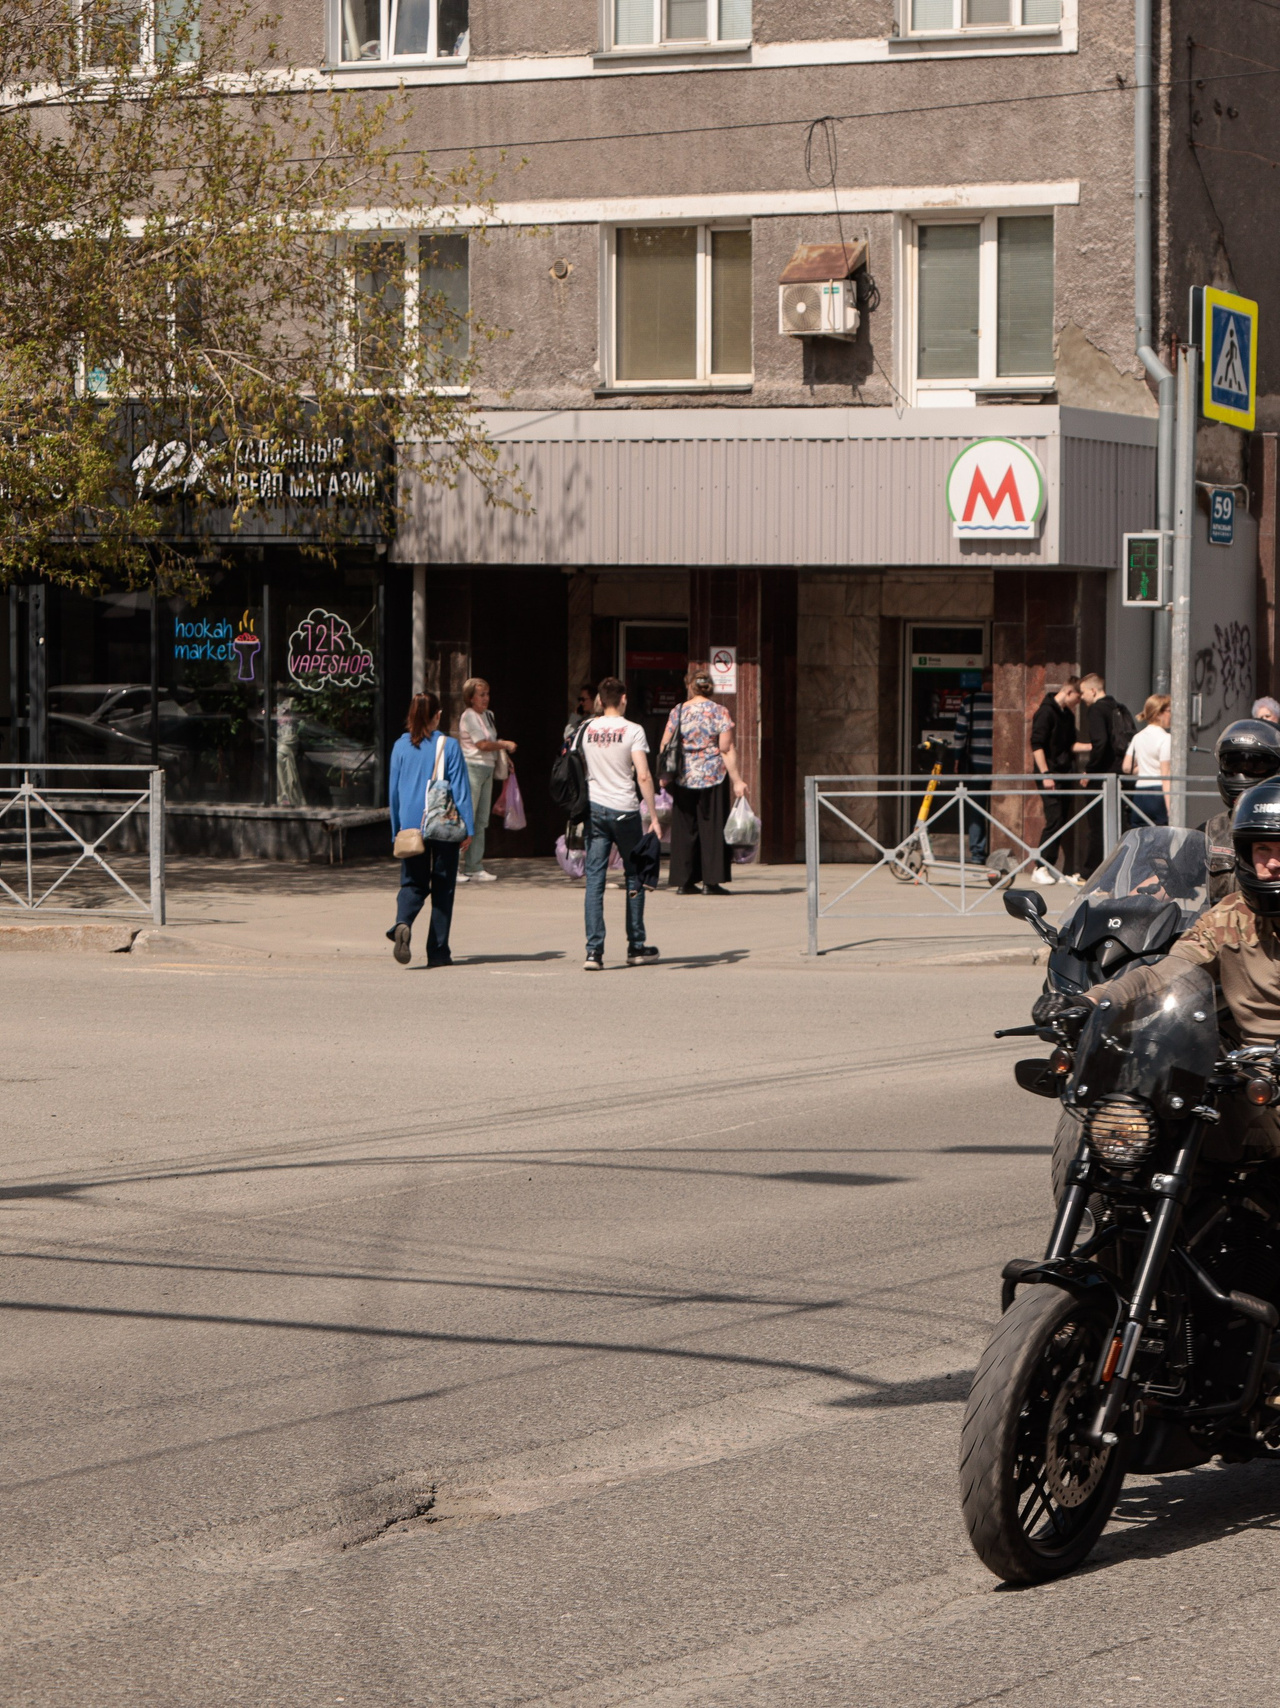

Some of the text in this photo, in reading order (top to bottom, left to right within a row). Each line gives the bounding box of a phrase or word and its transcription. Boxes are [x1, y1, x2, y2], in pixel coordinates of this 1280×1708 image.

[290, 471, 376, 498] МАГАЗИН
[1214, 496, 1232, 519] 59
[174, 617, 233, 639] hookah
[174, 640, 237, 661] market
[291, 654, 371, 674] VAPESHOP
[587, 732, 623, 743] RUSSIA
